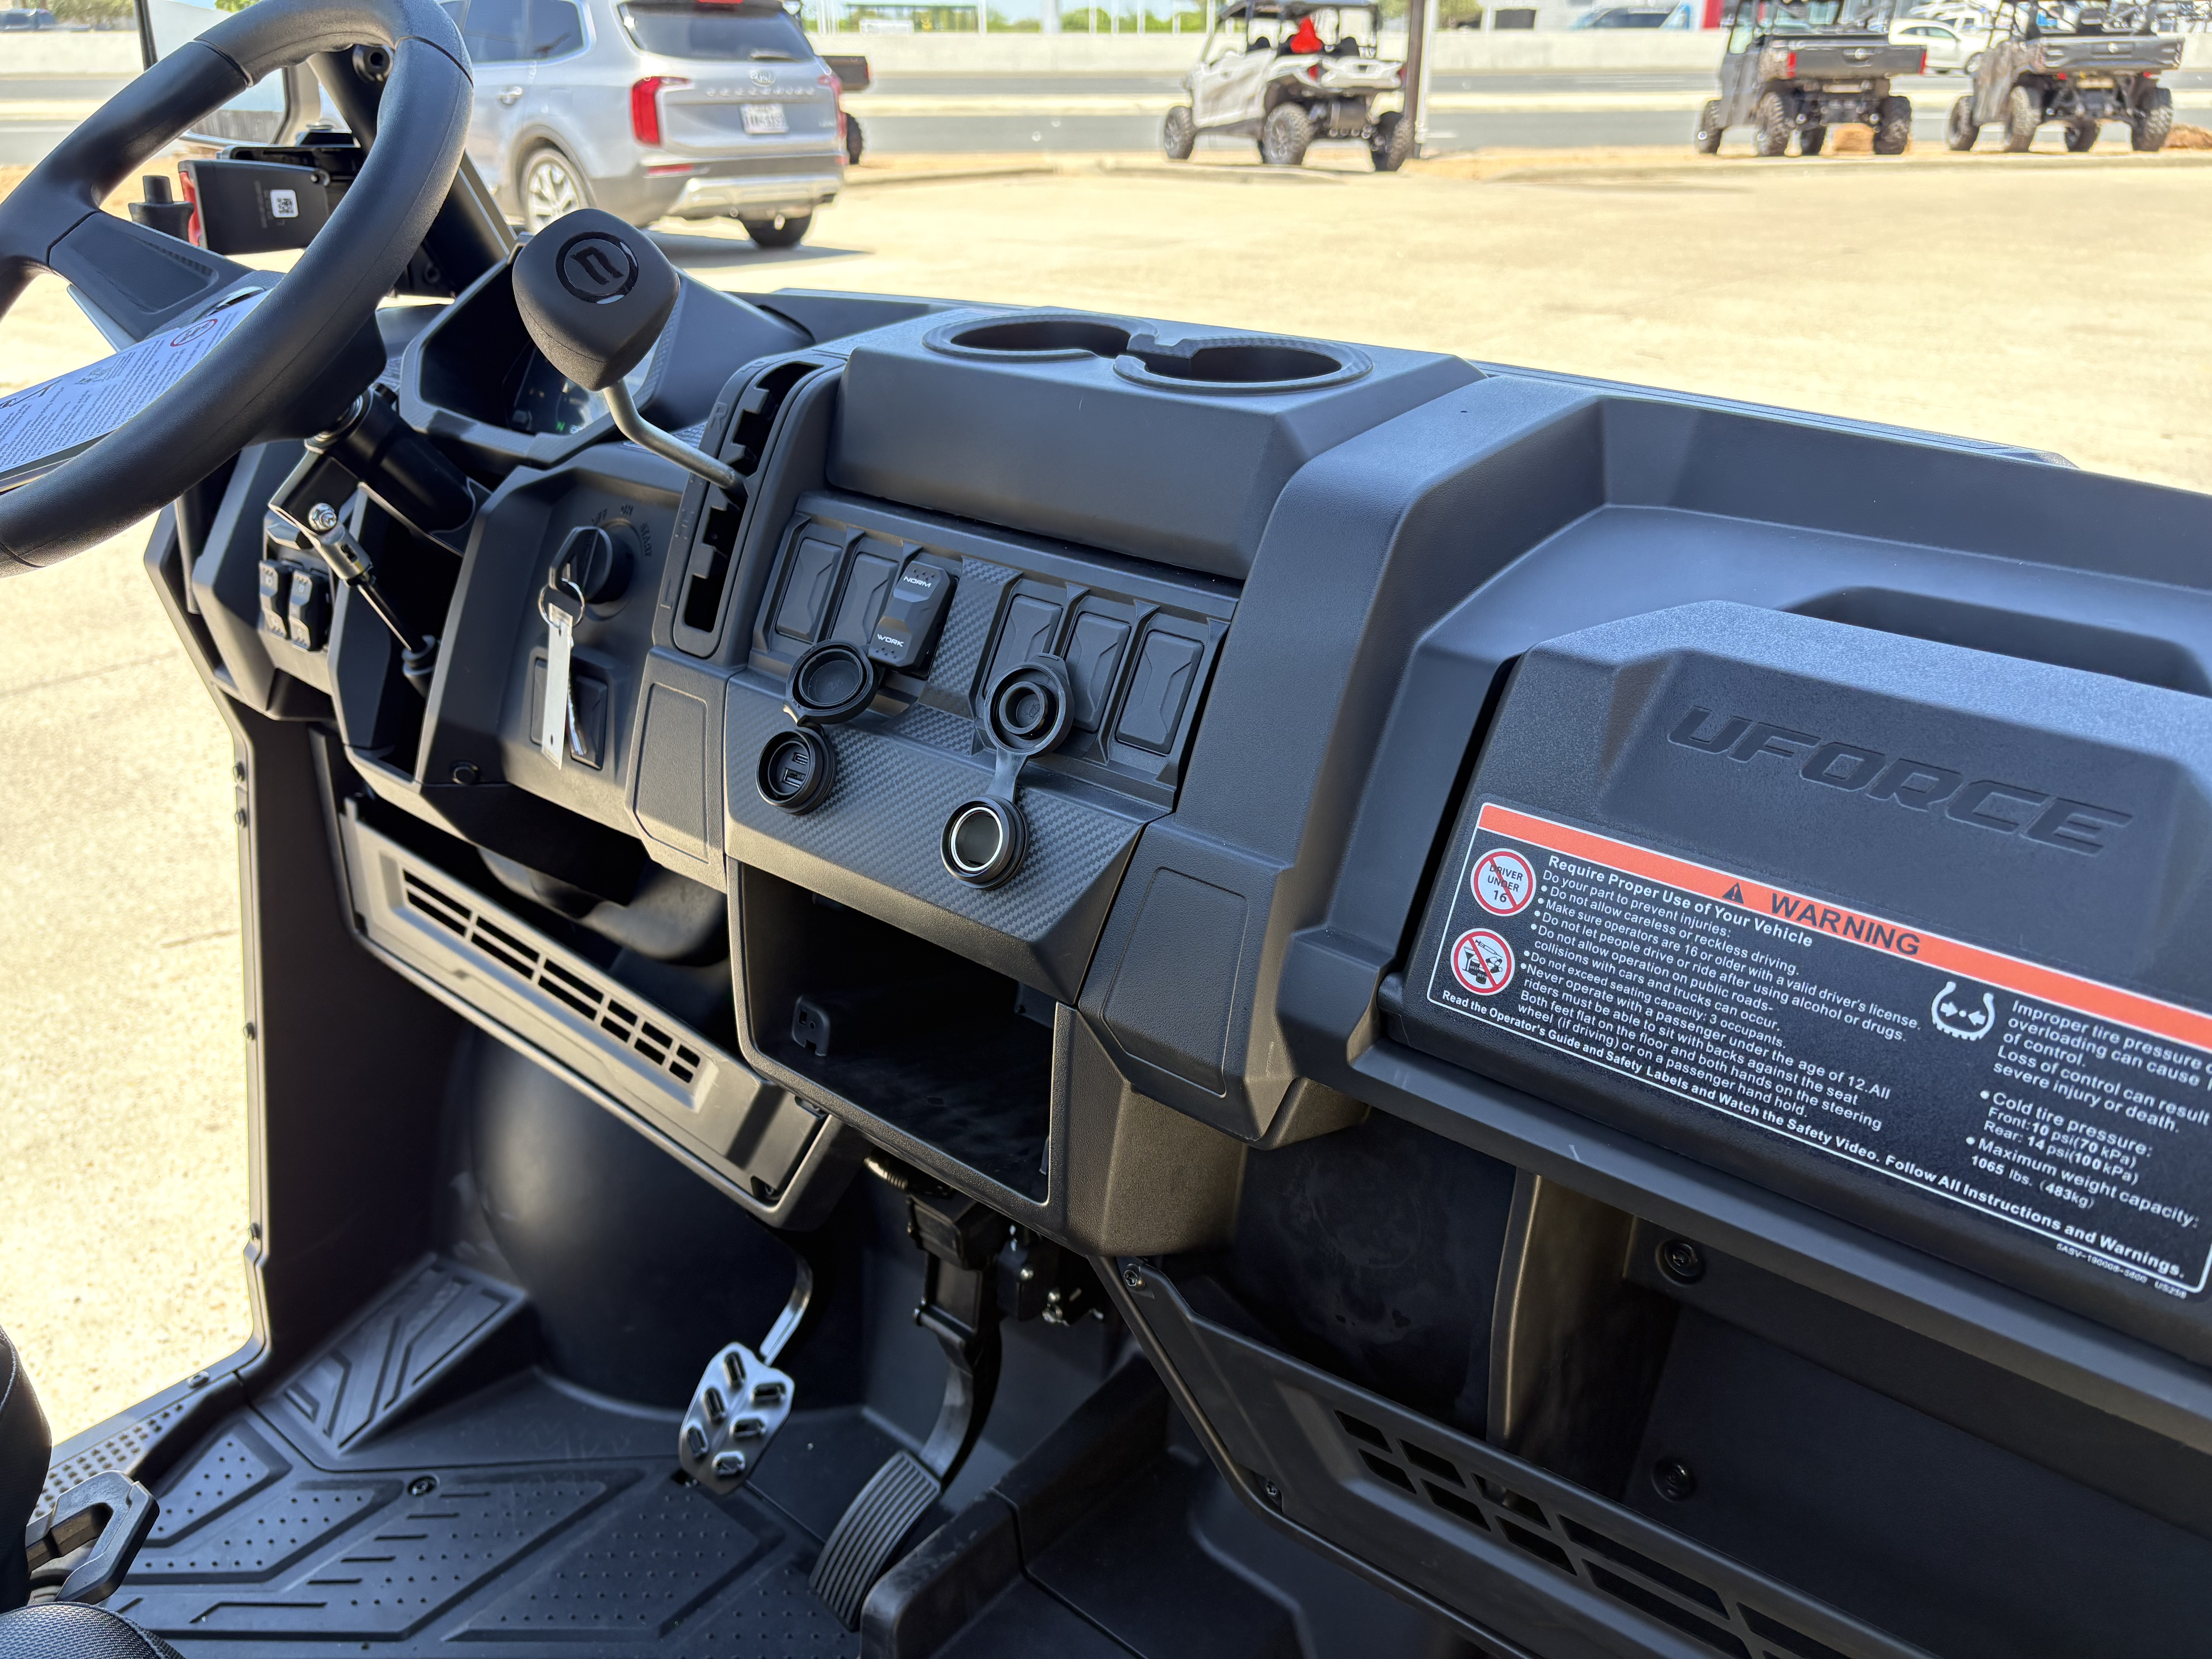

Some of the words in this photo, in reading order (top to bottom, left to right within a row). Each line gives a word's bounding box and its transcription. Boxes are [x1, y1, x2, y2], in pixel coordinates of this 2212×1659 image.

[711, 402, 728, 429] R
[903, 576, 932, 588] NORM
[878, 634, 904, 647] WORK
[1667, 706, 2133, 857] UFORCE
[1487, 874, 1520, 892] UNDER
[1489, 864, 1523, 882] DRIVER
[1493, 890, 1508, 903] 16
[1542, 869, 1559, 883] Do
[1560, 877, 1589, 892] your
[1589, 886, 1615, 901] part
[1616, 893, 1628, 905] to
[1630, 899, 1678, 921] prevent
[1680, 912, 1731, 938] injuries:
[1548, 855, 1605, 882] Require
[1608, 873, 1660, 899] Proper
[1662, 890, 1691, 909] Use
[1694, 903, 1712, 915] of
[1714, 905, 1751, 927] Your
[1754, 917, 1813, 947] Vehicle
[1550, 886, 1567, 900] Do
[1568, 894, 1589, 907] not
[1590, 901, 1623, 917] allow
[1624, 912, 1676, 935] careless
[1678, 929, 1693, 940] or
[1694, 934, 1748, 958] reckless
[1750, 951, 1799, 976] driving.
[1772, 893, 1920, 955] WARNING
[1534, 940, 1589, 965] collisions
[1592, 959, 1616, 974] with
[1618, 969, 1645, 984] cars
[1647, 979, 1671, 993] and
[1673, 985, 1712, 1007] trucks
[1714, 1001, 1738, 1017] can
[1740, 1010, 1780, 1032] occur.
[1538, 924, 1554, 939] Do
[1556, 933, 1576, 946] not
[1577, 940, 1609, 957] allow
[1611, 951, 1669, 978] operation
[1672, 972, 1688, 984] on
[1689, 978, 1729, 998] public
[1542, 912, 1559, 926] Do
[1560, 920, 1581, 933] not
[1582, 924, 1598, 939] let
[1598, 933, 1641, 953] people
[1643, 946, 1674, 964] drive
[1676, 958, 1691, 969] or
[1692, 962, 1717, 978] ride
[1719, 972, 1751, 989] after
[1753, 983, 1790, 1005] using
[1791, 996, 1843, 1020] alcohol
[1844, 1014, 1860, 1025] or
[1862, 1018, 1906, 1042] drugs.
[1546, 898, 1576, 917] Make
[1577, 911, 1602, 926] sure
[1604, 920, 1659, 945] operators
[1661, 939, 1681, 951] are
[1685, 944, 1698, 957] 16
[1700, 951, 1714, 962] or
[1714, 956, 1747, 973] older
[1748, 966, 1774, 982] with
[1787, 979, 1817, 996] valid
[1819, 988, 1867, 1012] driver's
[1868, 1003, 1920, 1030] license.
[1527, 963, 1565, 985] Never
[1565, 979, 1614, 1003] operate
[1617, 997, 1642, 1013] with
[1655, 1011, 1727, 1042] passenger
[1729, 1036, 1770, 1057] under
[1771, 1049, 1794, 1066] the
[1798, 1060, 1826, 1077] age
[1828, 1071, 1845, 1083] of
[1530, 951, 1546, 965] Do
[1548, 960, 1566, 972] not
[1567, 967, 1609, 987] exceed
[1609, 981, 1652, 1004] seating
[1654, 996, 1707, 1021] capacity:
[1720, 1019, 1786, 1049] occupants.
[1518, 1004, 1554, 1024] wheel
[1572, 1023, 1619, 1049] driving)
[1621, 1042, 1635, 1053] or
[1637, 1048, 1653, 1060] on
[1665, 1058, 1736, 1090] passenger
[1737, 1082, 1772, 1104] hand
[1774, 1095, 1807, 1118] hold.
[1520, 989, 1548, 1008] Both
[1550, 1000, 1575, 1018] feet
[1576, 1010, 1596, 1026] flat
[1598, 1020, 1614, 1032] on
[1616, 1024, 1636, 1040] the
[1639, 1032, 1669, 1051] floor
[1671, 1046, 1696, 1061] and
[1698, 1053, 1728, 1073] both
[1730, 1065, 1772, 1089] hands
[1775, 1084, 1793, 1097] on
[1796, 1089, 1819, 1106] the
[1821, 1101, 1882, 1132] steering
[1523, 978, 1559, 998] riders
[1561, 992, 1592, 1010] must
[1594, 1001, 1610, 1016] be
[1613, 1010, 1640, 1027] able
[1643, 1019, 1656, 1032] to
[1658, 1027, 1675, 1040] sit
[1677, 1033, 1704, 1050] with
[1705, 1041, 1745, 1064] backs
[1747, 1059, 1799, 1084] against
[1801, 1076, 1824, 1092] the
[1826, 1087, 1858, 1106] seat
[2002, 1032, 2022, 1046] of
[2023, 1039, 2086, 1067] control.
[2008, 1018, 2108, 1060] overloading
[2111, 1050, 2143, 1068] can
[2012, 1000, 2088, 1033] Improper
[2092, 1026, 2120, 1044] tire
[2122, 1038, 2203, 1070] pressure
[1993, 1063, 2050, 1089] severe
[2052, 1080, 2102, 1108] injury
[2104, 1099, 2124, 1113] or
[1997, 1045, 2037, 1068] Loss
[2040, 1062, 2059, 1075] of
[2060, 1068, 2121, 1096] control
[2123, 1088, 2155, 1108] can
[1442, 989, 1469, 1008] Read
[1470, 1001, 1487, 1015] the
[1489, 1007, 1546, 1036] Operator's
[1548, 1029, 1581, 1049] Guide
[1582, 1044, 1604, 1058] and
[1605, 1050, 1643, 1074] Safety
[1646, 1065, 1689, 1090] Labels
[1691, 1084, 1716, 1101] and
[1719, 1092, 1760, 1116] Watch
[1762, 1109, 1784, 1126] the
[1786, 1118, 1833, 1145] Safety
[1836, 1135, 1880, 1162] Video.
[1885, 1154, 1937, 1182] Follow
[1937, 1175, 1961, 1192] All
[1963, 1183, 2061, 1230] Instructions
[2064, 1225, 2097, 1244] and
[2100, 1235, 2184, 1278] Warnings.
[1992, 1092, 2034, 1116] Cold
[2035, 1106, 2064, 1126] tire
[2066, 1120, 2153, 1158] pressure:
[2027, 1135, 2045, 1151] 14
[1971, 1155, 2005, 1175] 1065
[1978, 1137, 2057, 1177] Maximum
[2061, 1170, 2118, 1199] weight
[2119, 1191, 2199, 1228] capacity:
